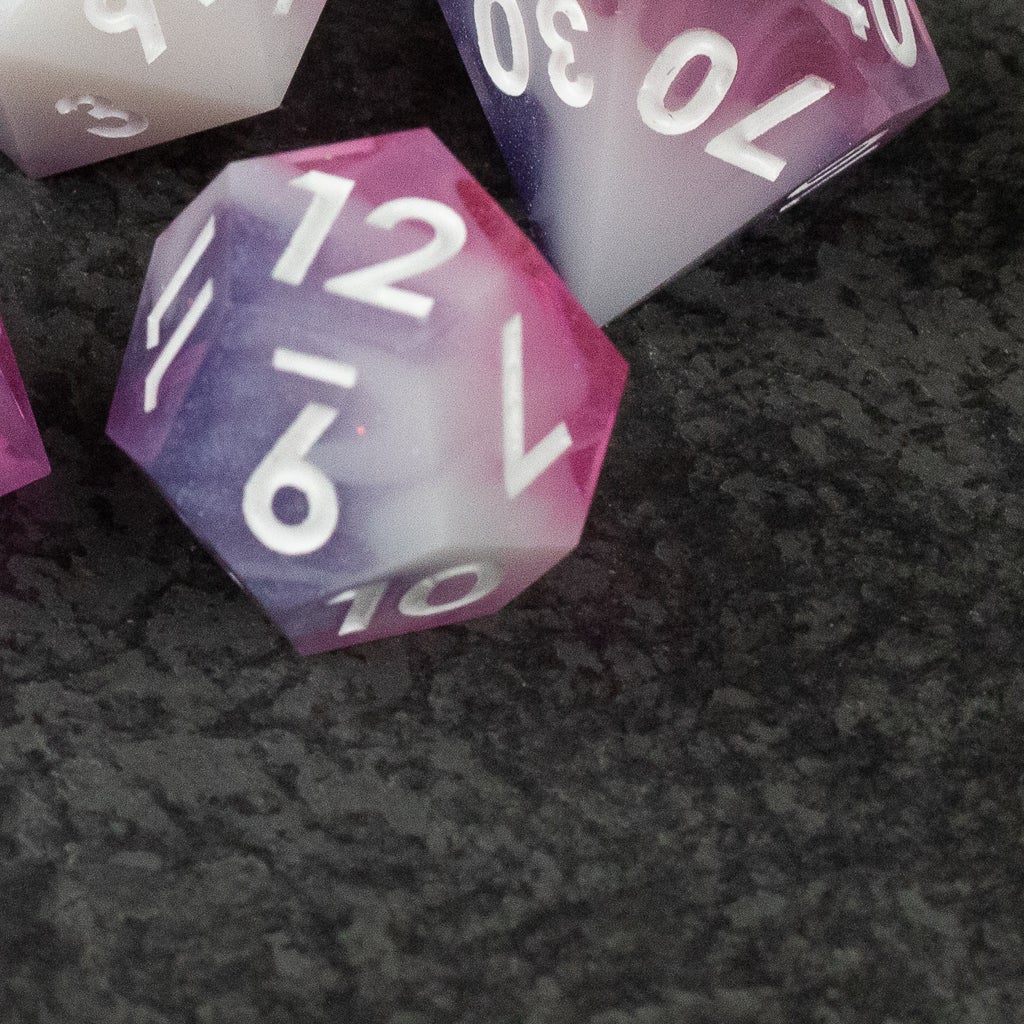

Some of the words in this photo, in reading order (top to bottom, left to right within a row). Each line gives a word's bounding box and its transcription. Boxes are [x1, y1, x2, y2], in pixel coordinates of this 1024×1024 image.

[636, 27, 835, 183] 70
[272, 169, 468, 319] 12
[327, 562, 501, 637] 10
